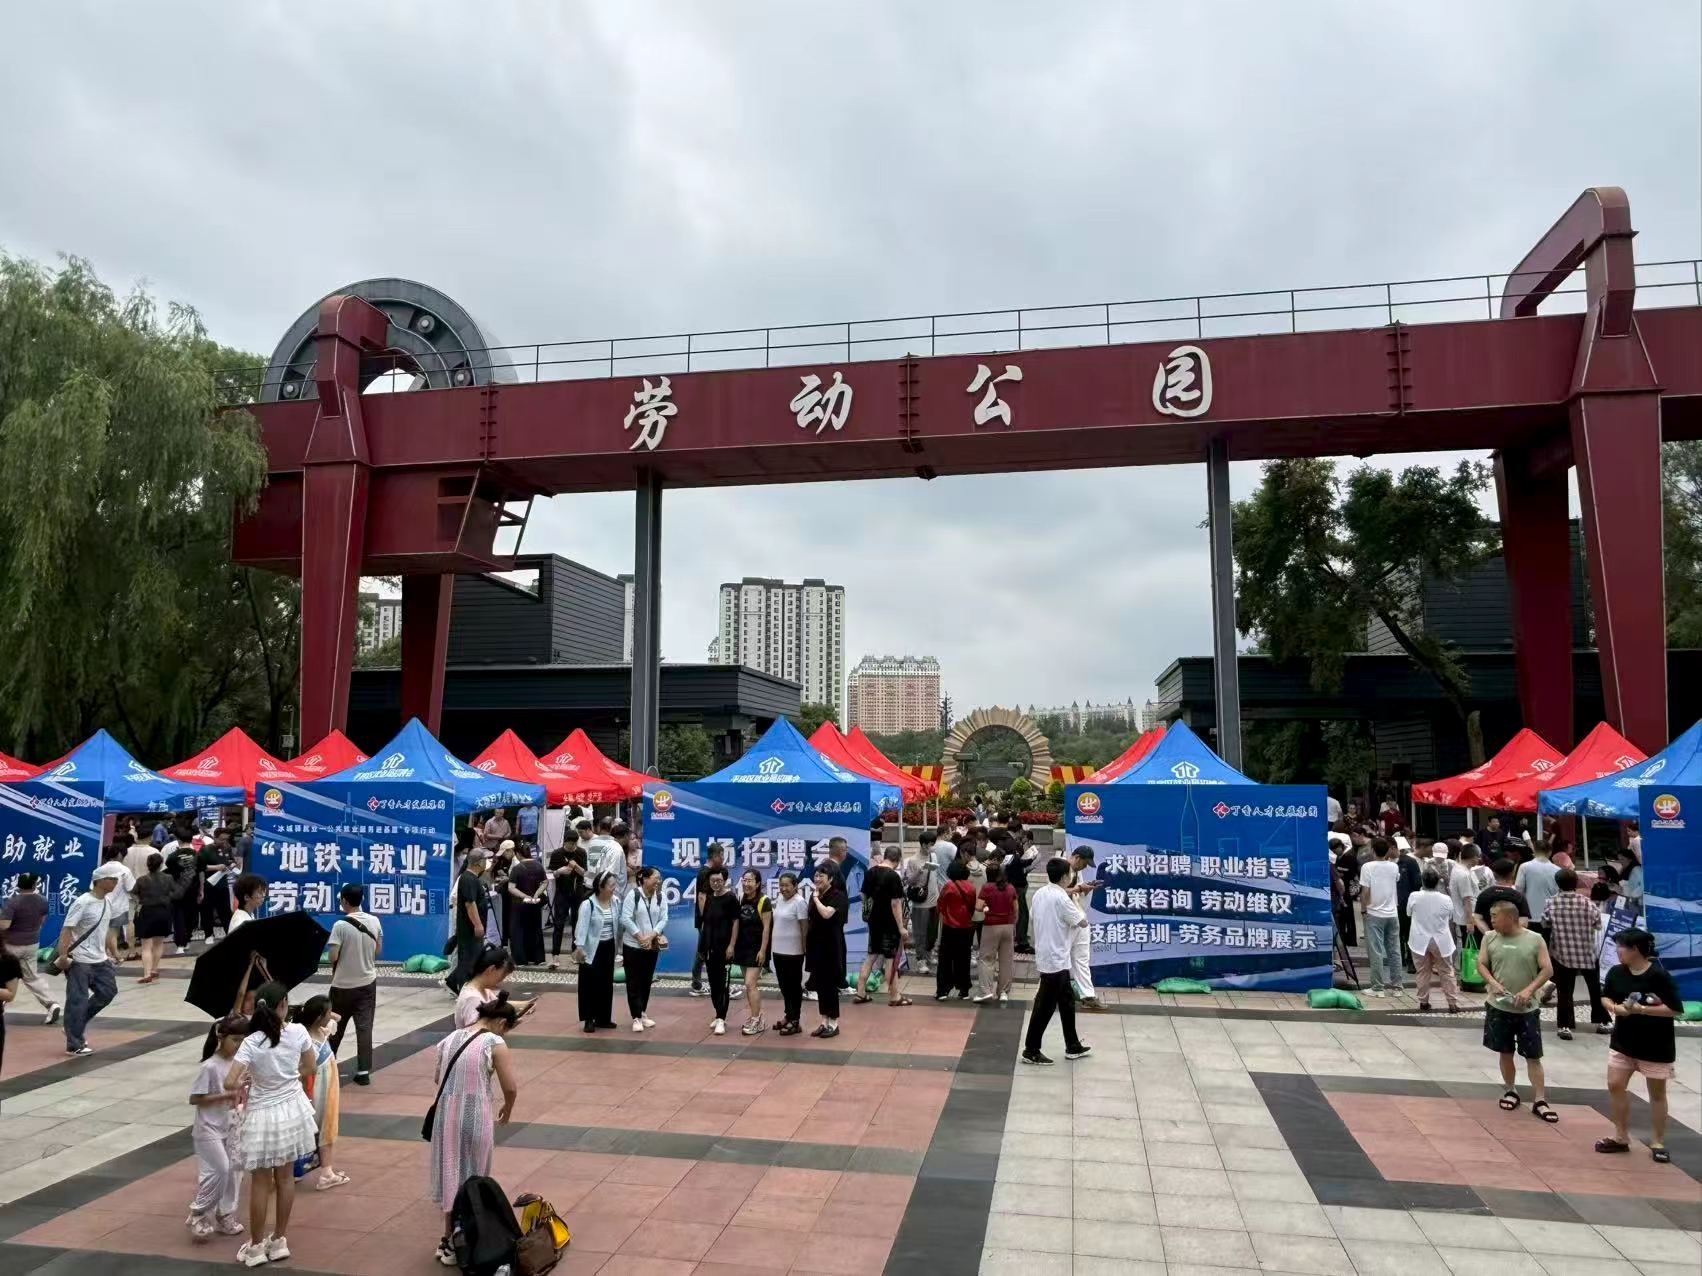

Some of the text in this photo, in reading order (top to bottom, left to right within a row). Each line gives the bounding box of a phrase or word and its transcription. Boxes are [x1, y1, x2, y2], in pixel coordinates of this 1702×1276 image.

[623, 345, 1213, 451] 劳动公园
[2, 833, 84, 864] 助就业
[1105, 855, 1292, 880] 求职招聘 职业指导
[268, 881, 427, 916] 劳动园站
[1105, 888, 1293, 915] 政策咨询 劳动维权
[1179, 924, 1318, 951] 劳务品牌展示
